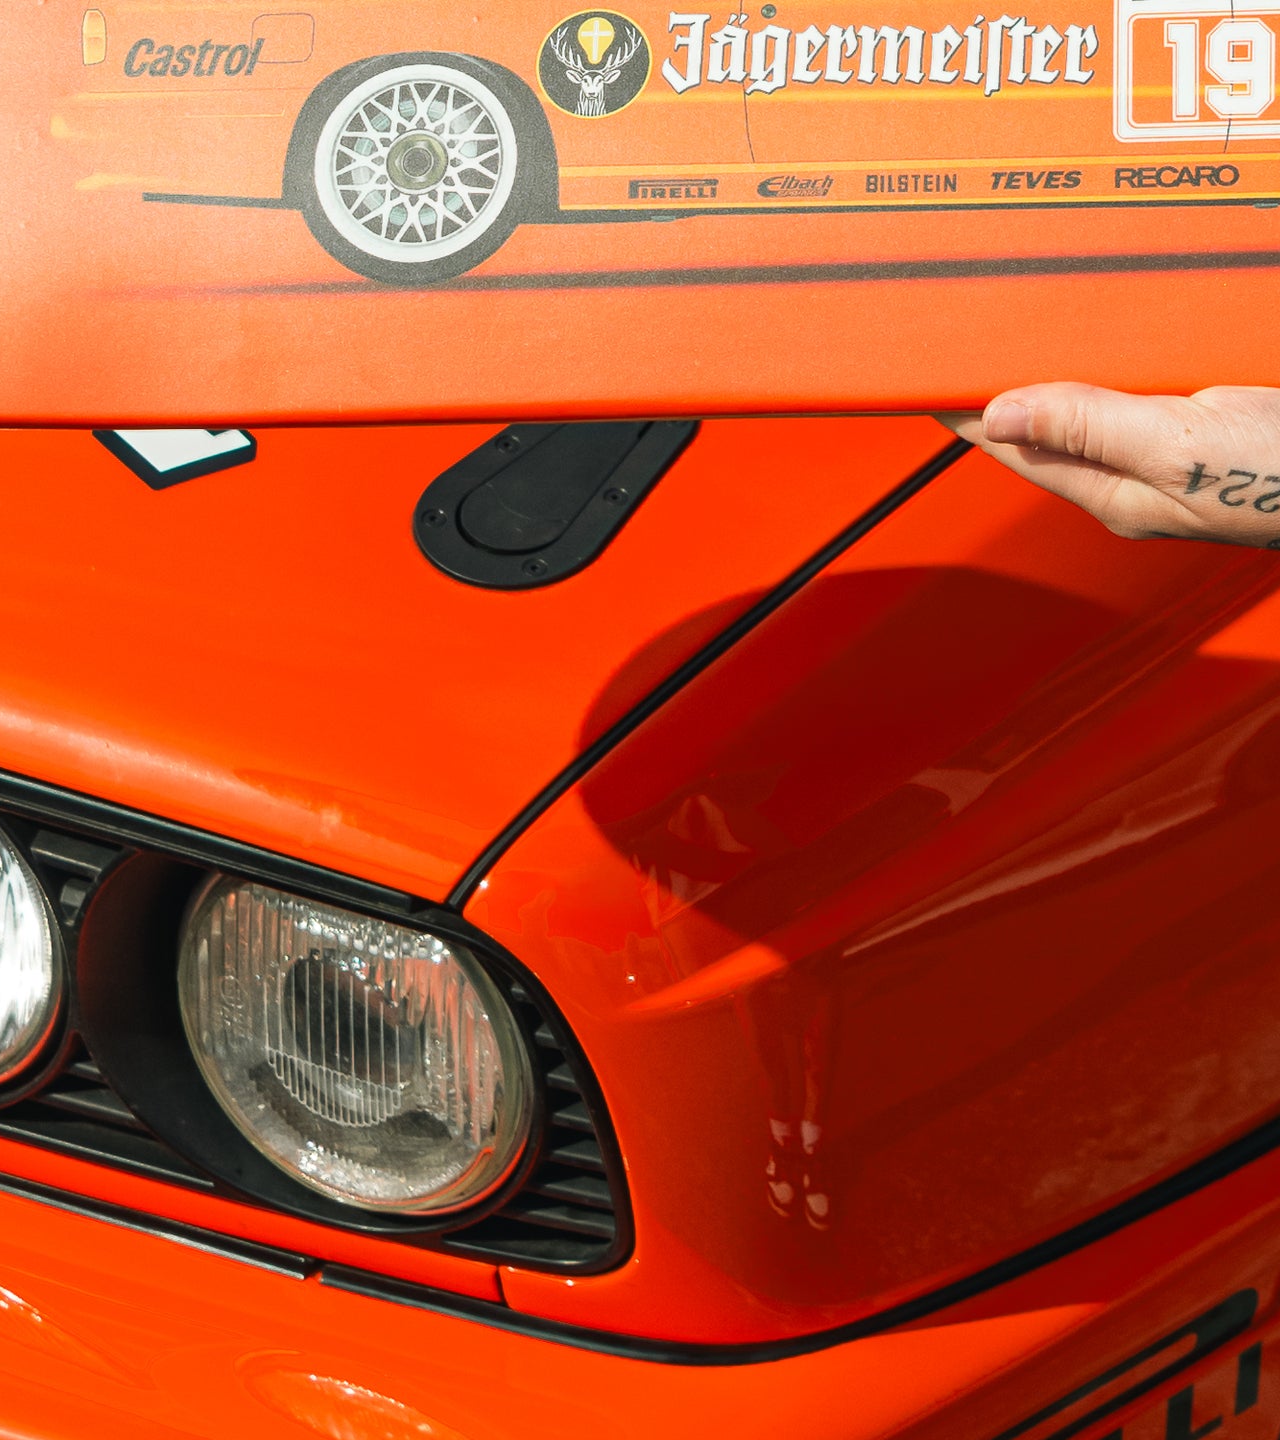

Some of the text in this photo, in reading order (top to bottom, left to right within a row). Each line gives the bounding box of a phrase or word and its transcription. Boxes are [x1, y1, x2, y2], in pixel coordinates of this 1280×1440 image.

[123, 35, 265, 79] Castrol
[1162, 18, 1277, 120] 19
[865, 173, 957, 194] BILSTEIN
[990, 170, 1082, 190] TEVES
[1114, 164, 1240, 189] RECARO
[628, 178, 719, 199] PIRELLI
